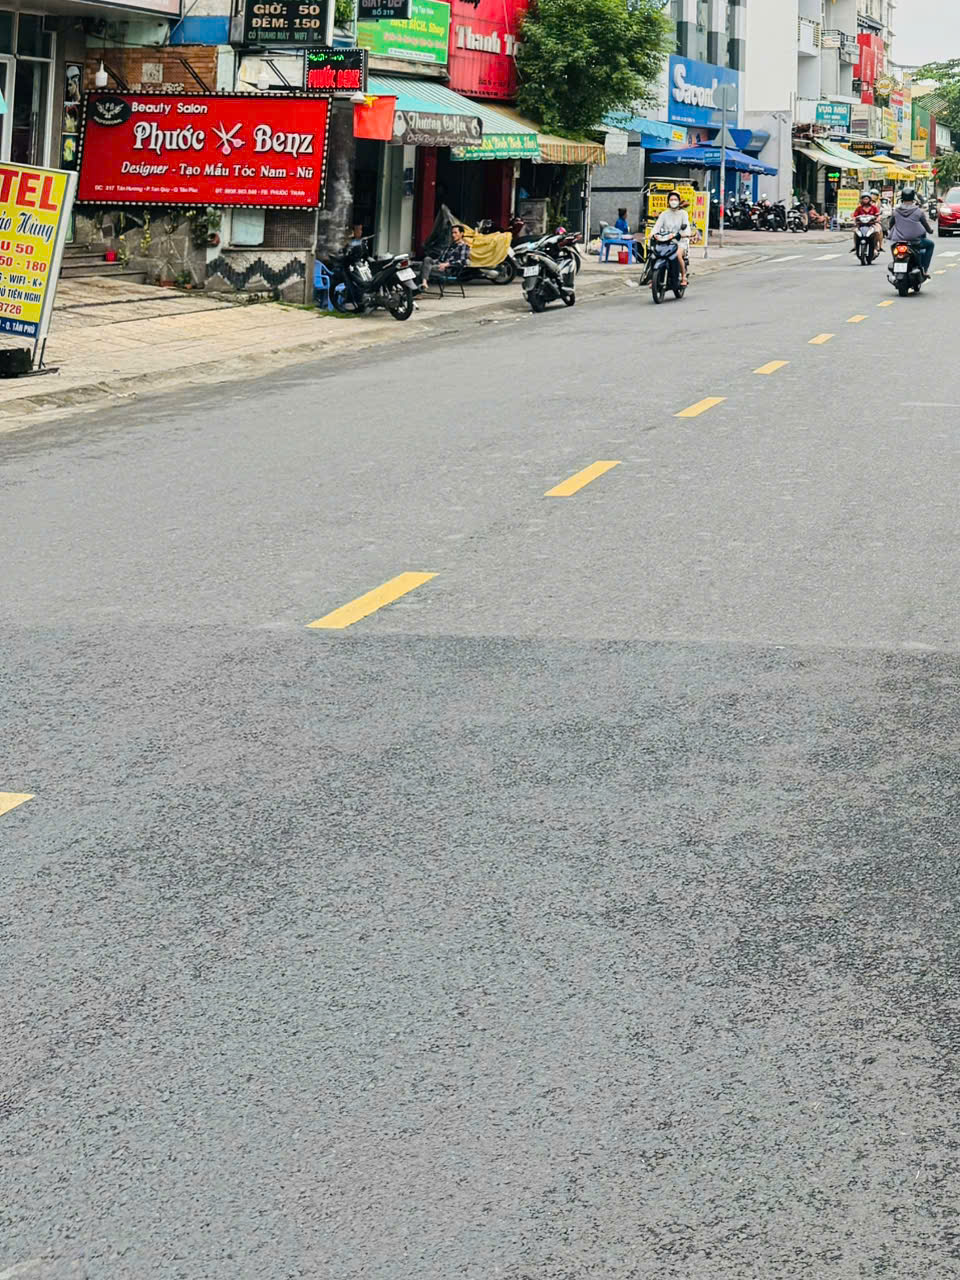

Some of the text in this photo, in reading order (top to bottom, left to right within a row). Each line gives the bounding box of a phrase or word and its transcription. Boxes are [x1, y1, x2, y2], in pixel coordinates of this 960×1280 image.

[253, 2, 321, 15] GIỜ: 50
[251, 16, 321, 29] ĐÊM: 150
[456, 25, 501, 55] Thanh
[672, 63, 737, 112] Sacom
[131, 102, 208, 115] Beauty Salon
[133, 121, 314, 158] Phước Benz
[121, 161, 169, 176] Designer
[179, 163, 201, 179] Tạo
[204, 162, 229, 177] Mẫu
[233, 164, 256, 177] Tóc
[260, 165, 287, 178] Nam
[296, 165, 314, 179] Nữ
[0, 168, 57, 211] TEL
[17, 211, 54, 242] Hùng
[16, 243, 34, 255] 50
[0, 256, 13, 267] 50
[26, 259, 47, 273] 180
[9, 274, 43, 288] WIFI K+
[7, 288, 23, 301] TIỆN
[23, 292, 41, 303] NGHI
